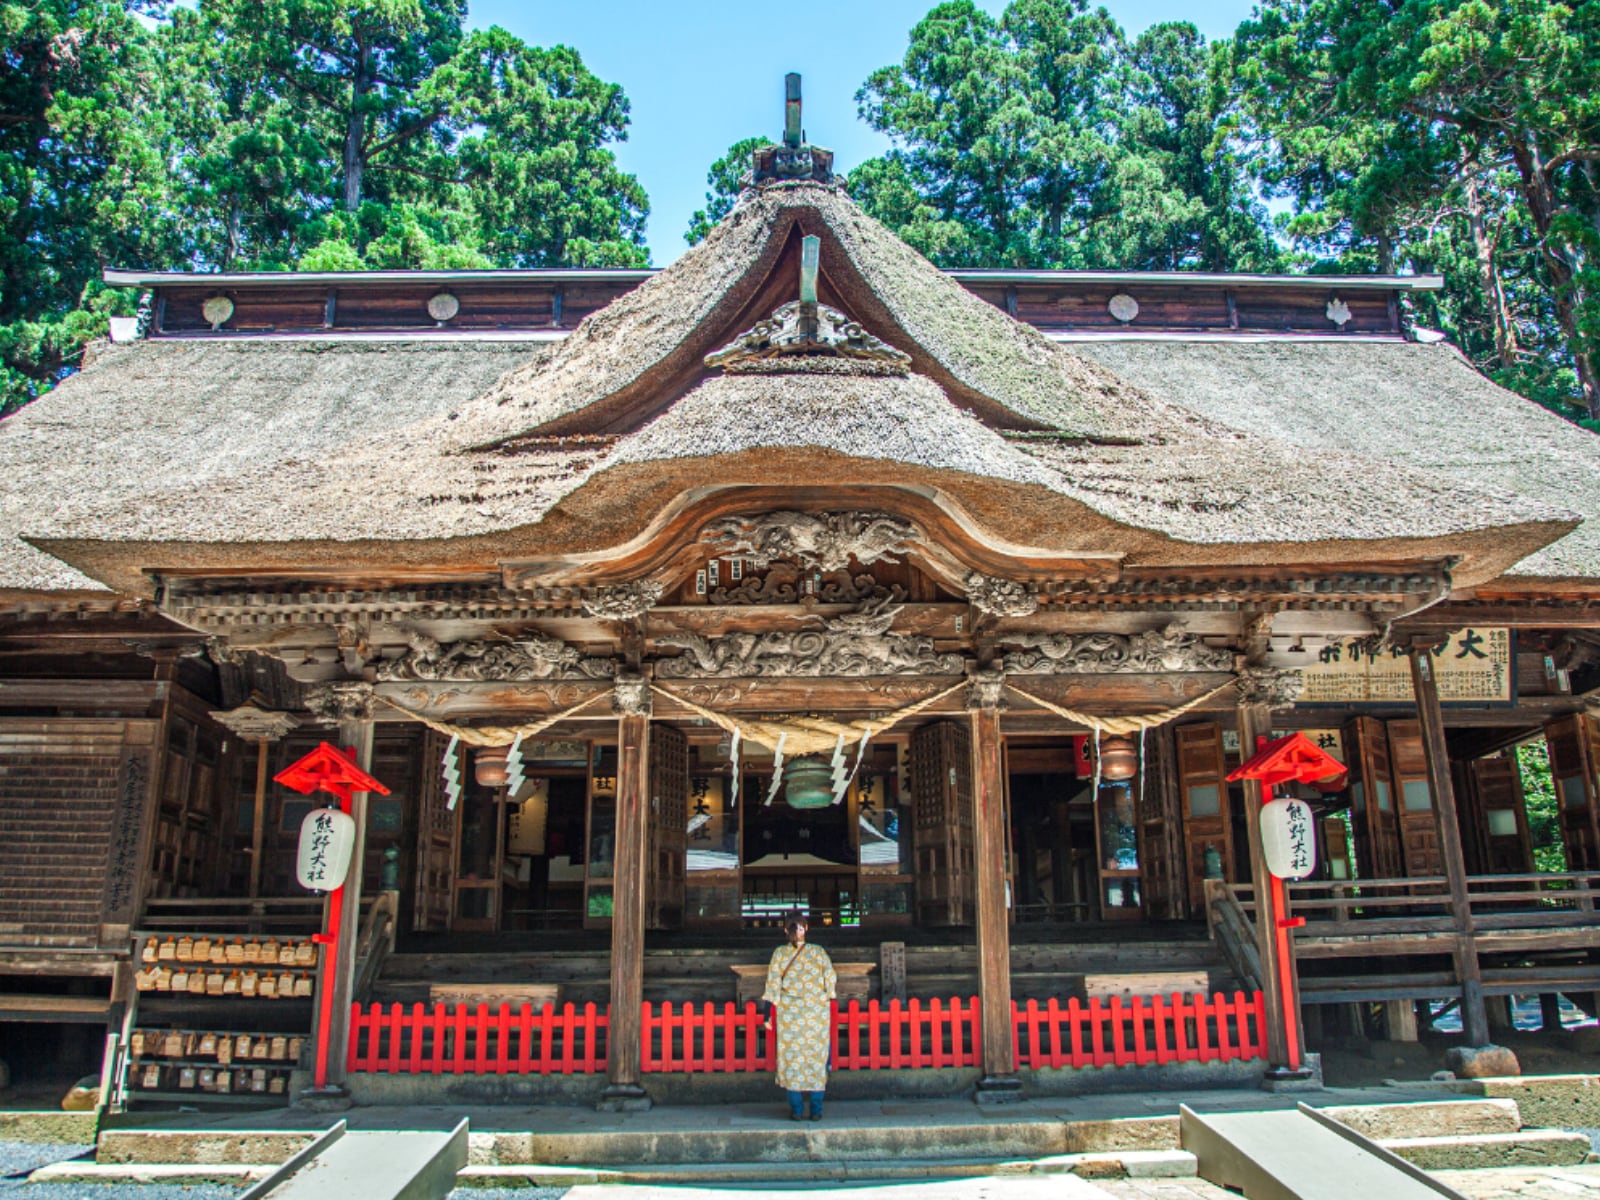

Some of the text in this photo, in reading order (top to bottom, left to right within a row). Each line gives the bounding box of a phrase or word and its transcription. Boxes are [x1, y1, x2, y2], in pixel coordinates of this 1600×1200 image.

[306, 813, 335, 882] 熊野大社
[1285, 801, 1309, 870] 熊野大社
